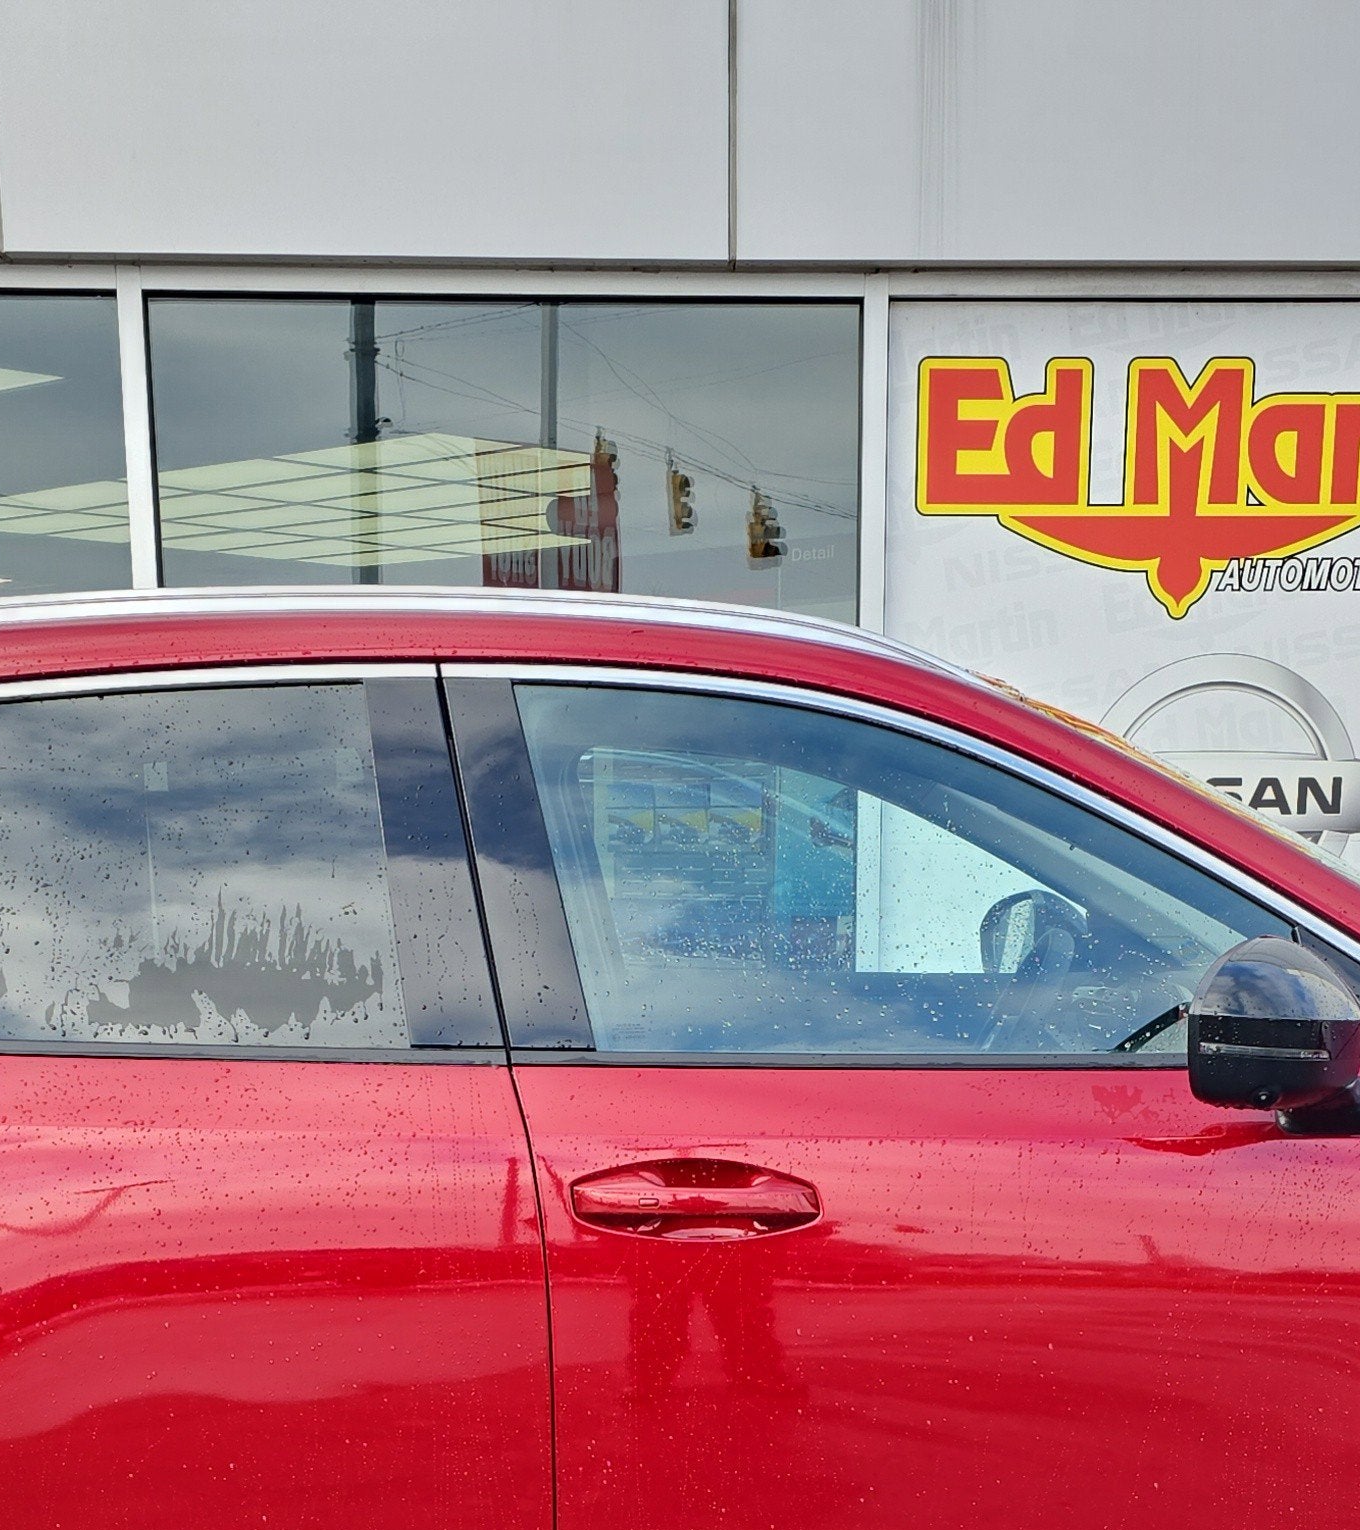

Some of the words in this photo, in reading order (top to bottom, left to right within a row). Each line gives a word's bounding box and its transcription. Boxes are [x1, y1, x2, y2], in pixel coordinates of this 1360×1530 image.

[920, 362, 1088, 510] Ed
[791, 544, 835, 561] Detail
[1205, 774, 1344, 818] SAN
